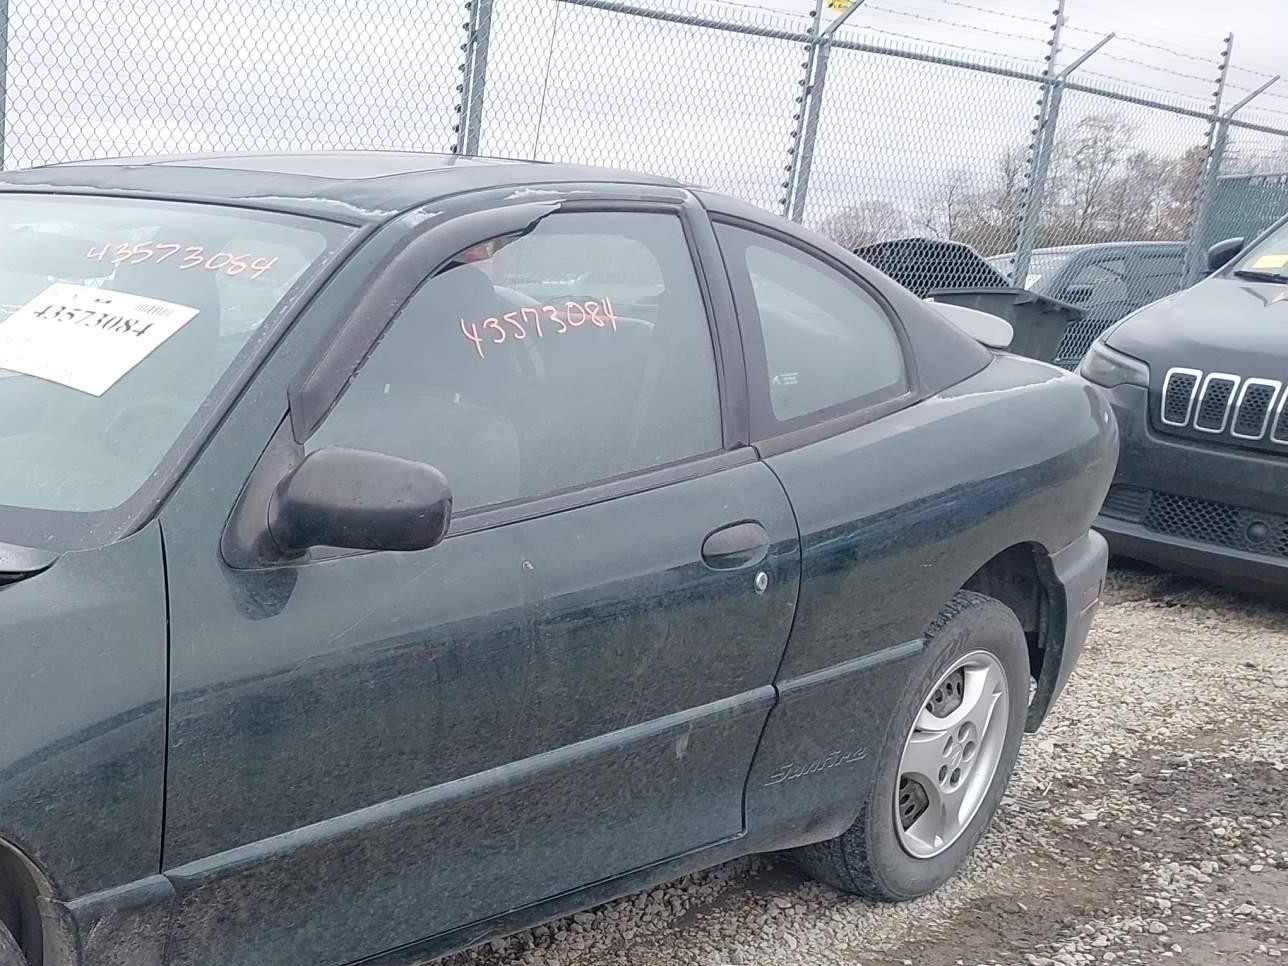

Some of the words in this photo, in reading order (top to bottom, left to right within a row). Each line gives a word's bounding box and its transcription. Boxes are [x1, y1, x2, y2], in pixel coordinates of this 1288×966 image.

[85, 240, 279, 281] 43573084
[32, 303, 155, 337] 43573084
[459, 297, 618, 360] 43573084
